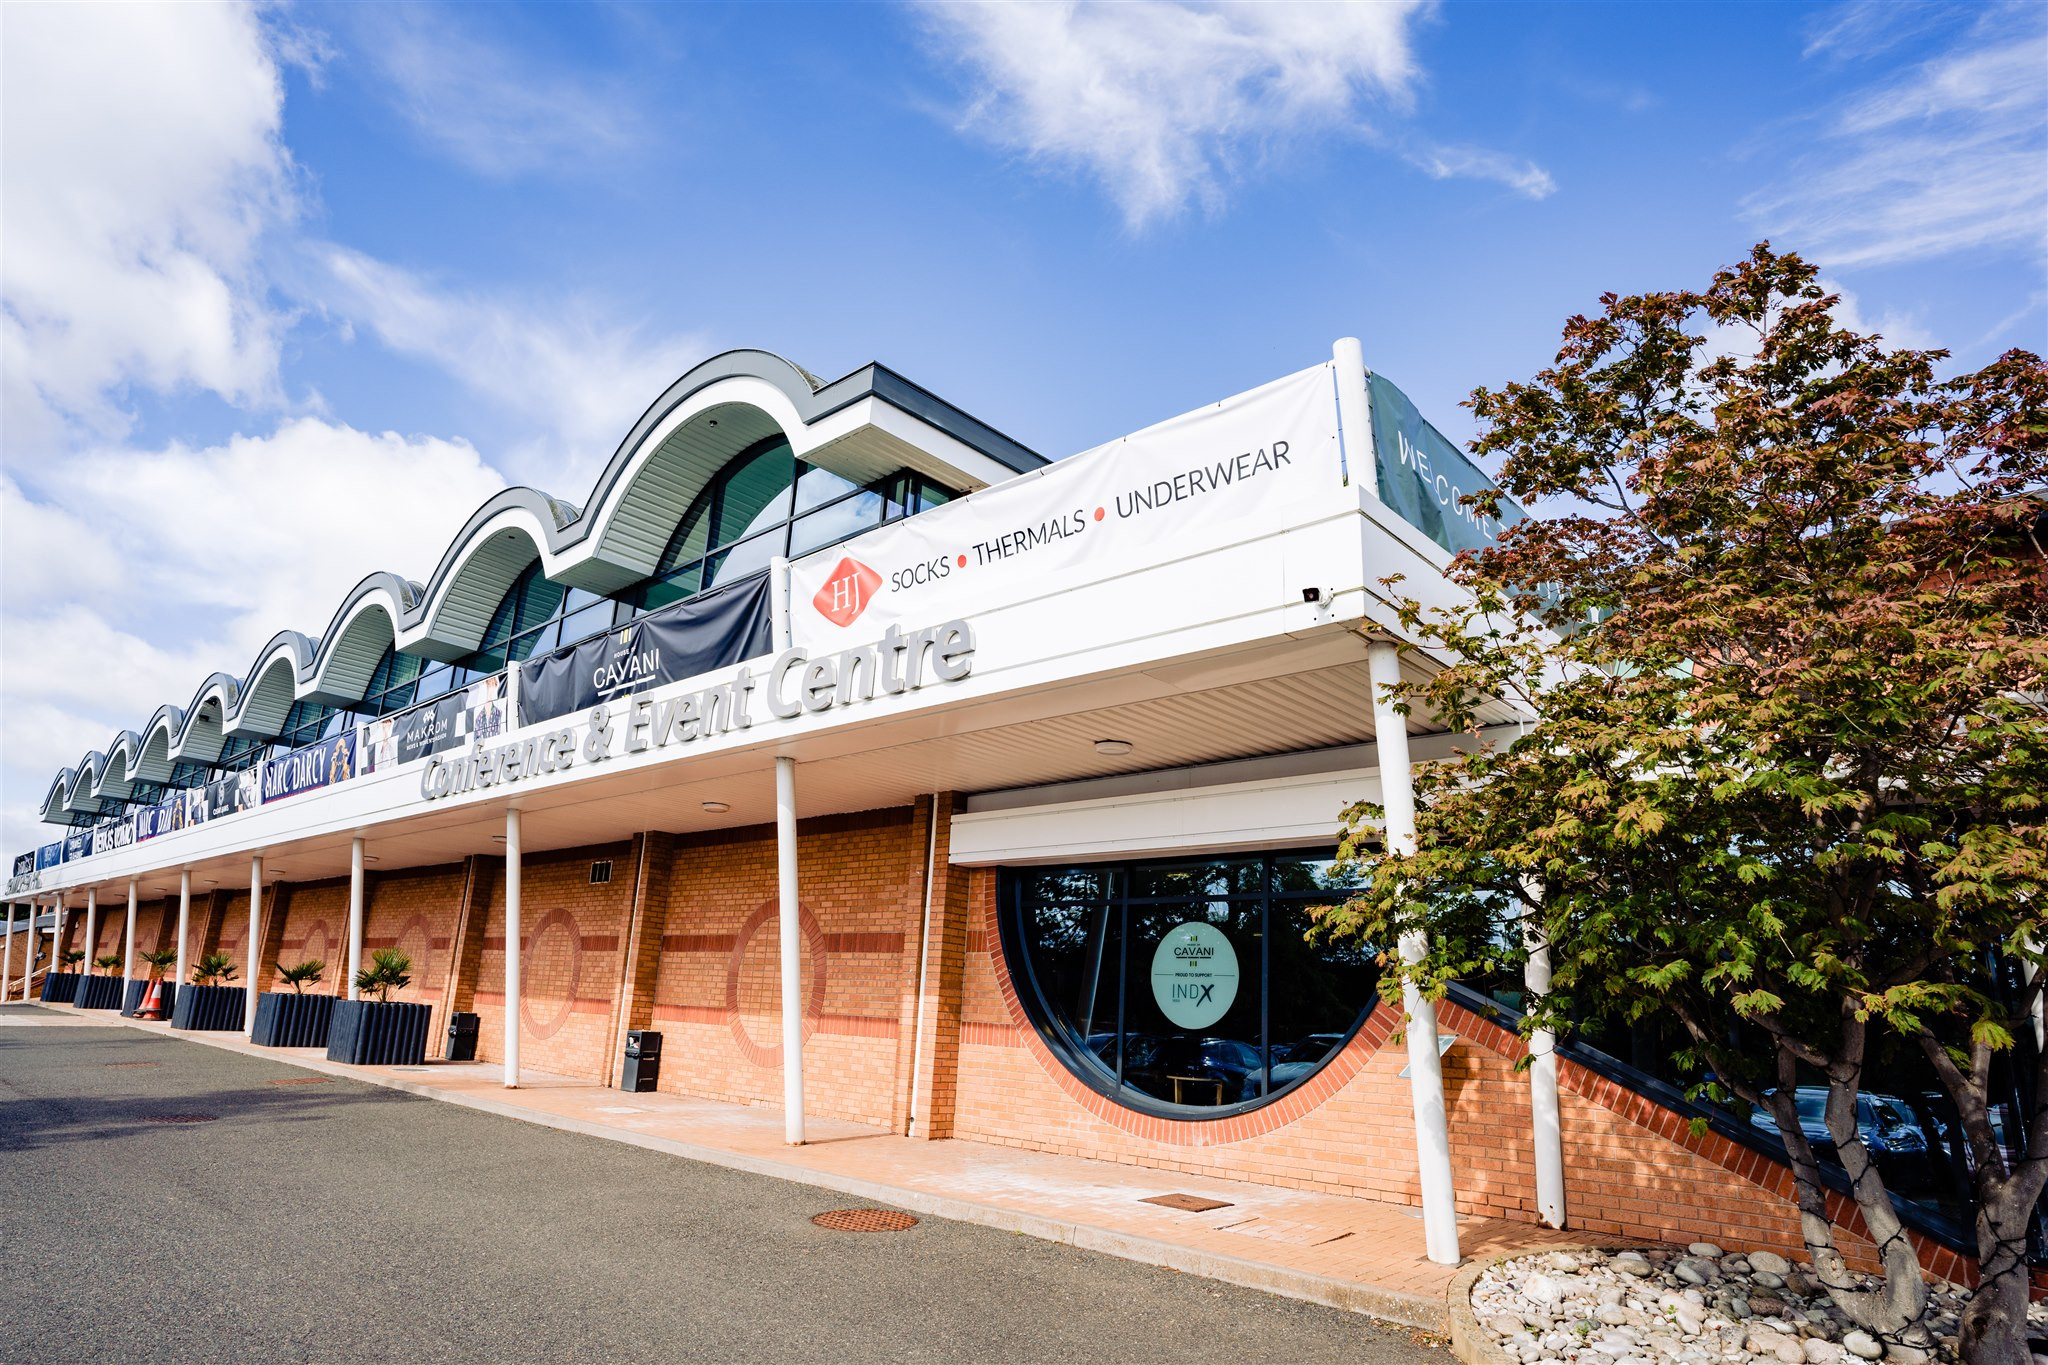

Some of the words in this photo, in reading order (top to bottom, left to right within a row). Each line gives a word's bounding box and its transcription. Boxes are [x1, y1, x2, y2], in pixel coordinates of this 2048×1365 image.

[891, 555, 951, 593] SOCKS
[972, 509, 1086, 566] THERMALS
[1115, 440, 1292, 519] UNDERWEAR
[831, 572, 861, 617] HJ
[593, 648, 660, 689] CAVANI
[406, 718, 447, 743] MAKROM
[420, 727, 577, 801] Conference
[583, 705, 614, 763] &
[625, 666, 757, 753] Event
[767, 618, 976, 719] Centre
[293, 747, 327, 790] DARCY
[1174, 947, 1214, 956] CAVANI
[1172, 984, 1215, 1007] INDX
